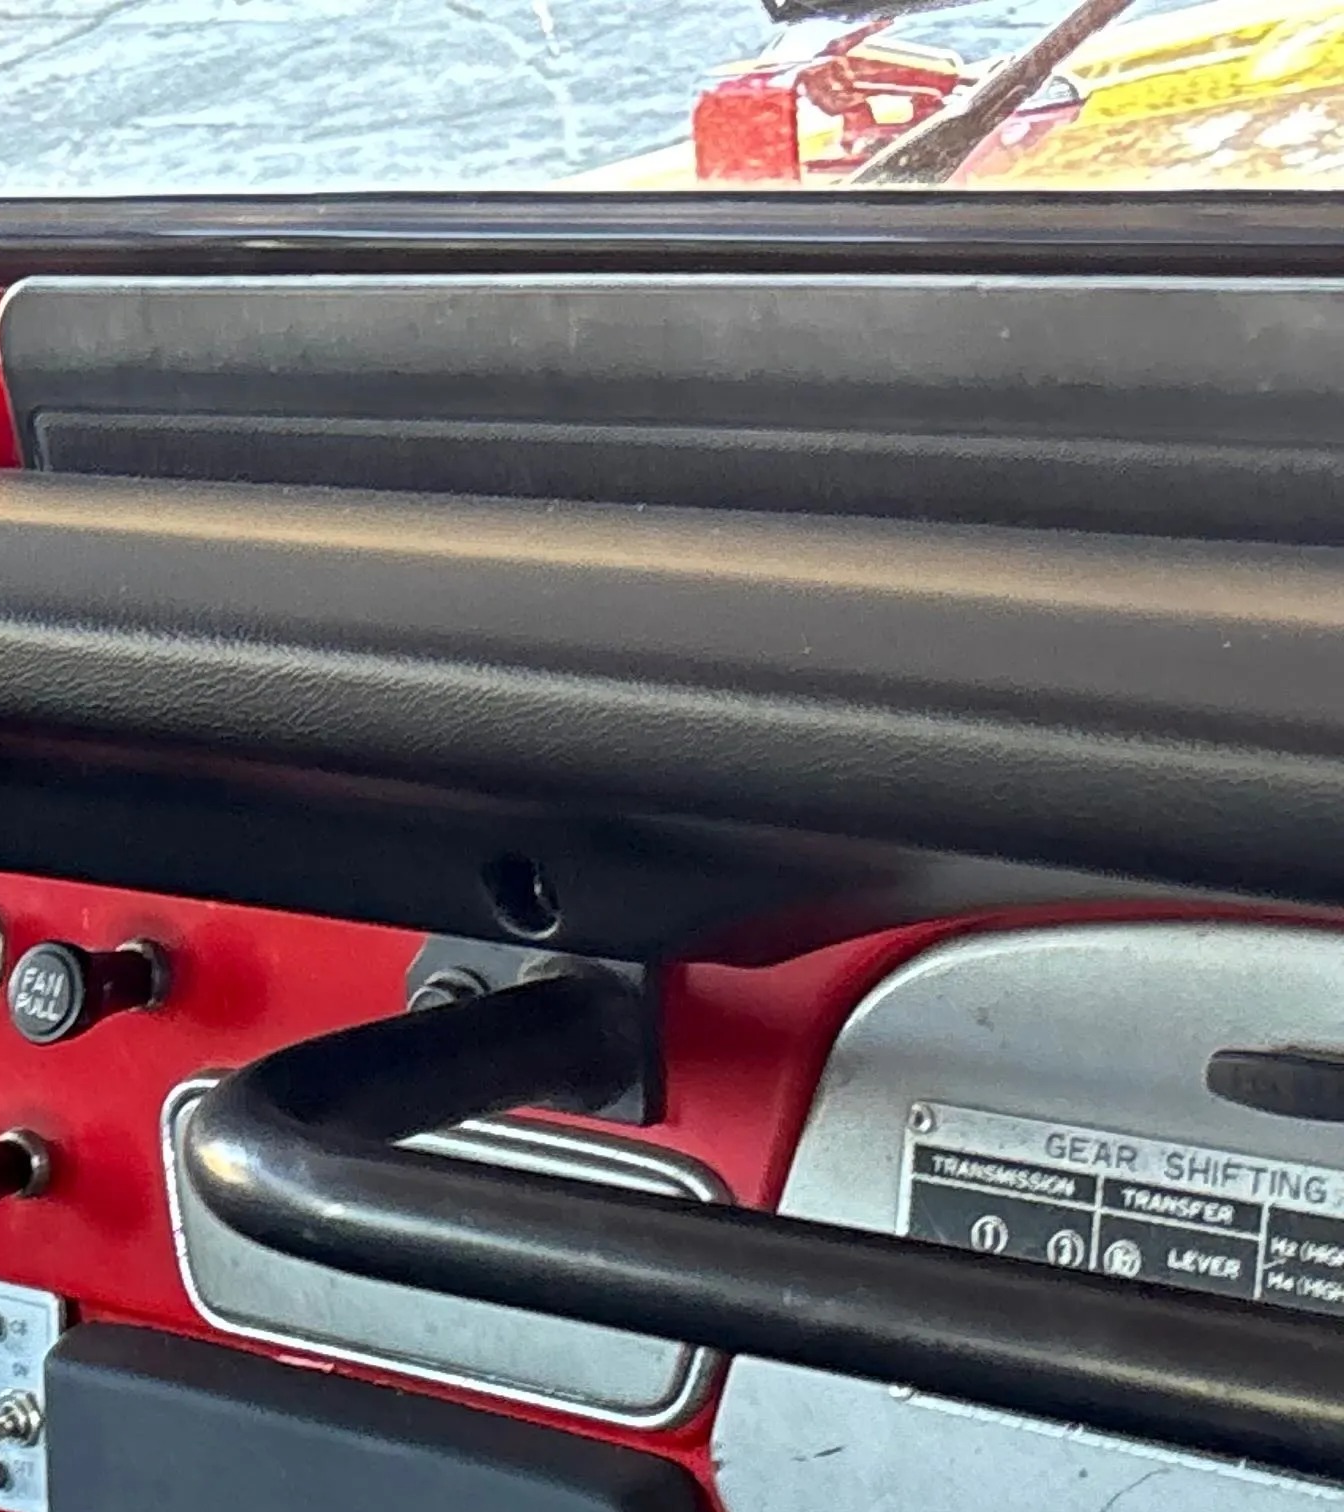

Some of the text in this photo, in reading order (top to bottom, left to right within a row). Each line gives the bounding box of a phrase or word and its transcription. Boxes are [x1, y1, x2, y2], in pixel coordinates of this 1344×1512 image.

[20, 967, 65, 997] FAN
[15, 993, 63, 1021] PULL
[931, 1154, 1076, 1197] TRANSMISSION
[1045, 1133, 1327, 1204] GEAR SHIFTING
[1120, 1186, 1235, 1225] TRANSFER
[1167, 1248, 1242, 1280] LEVER
